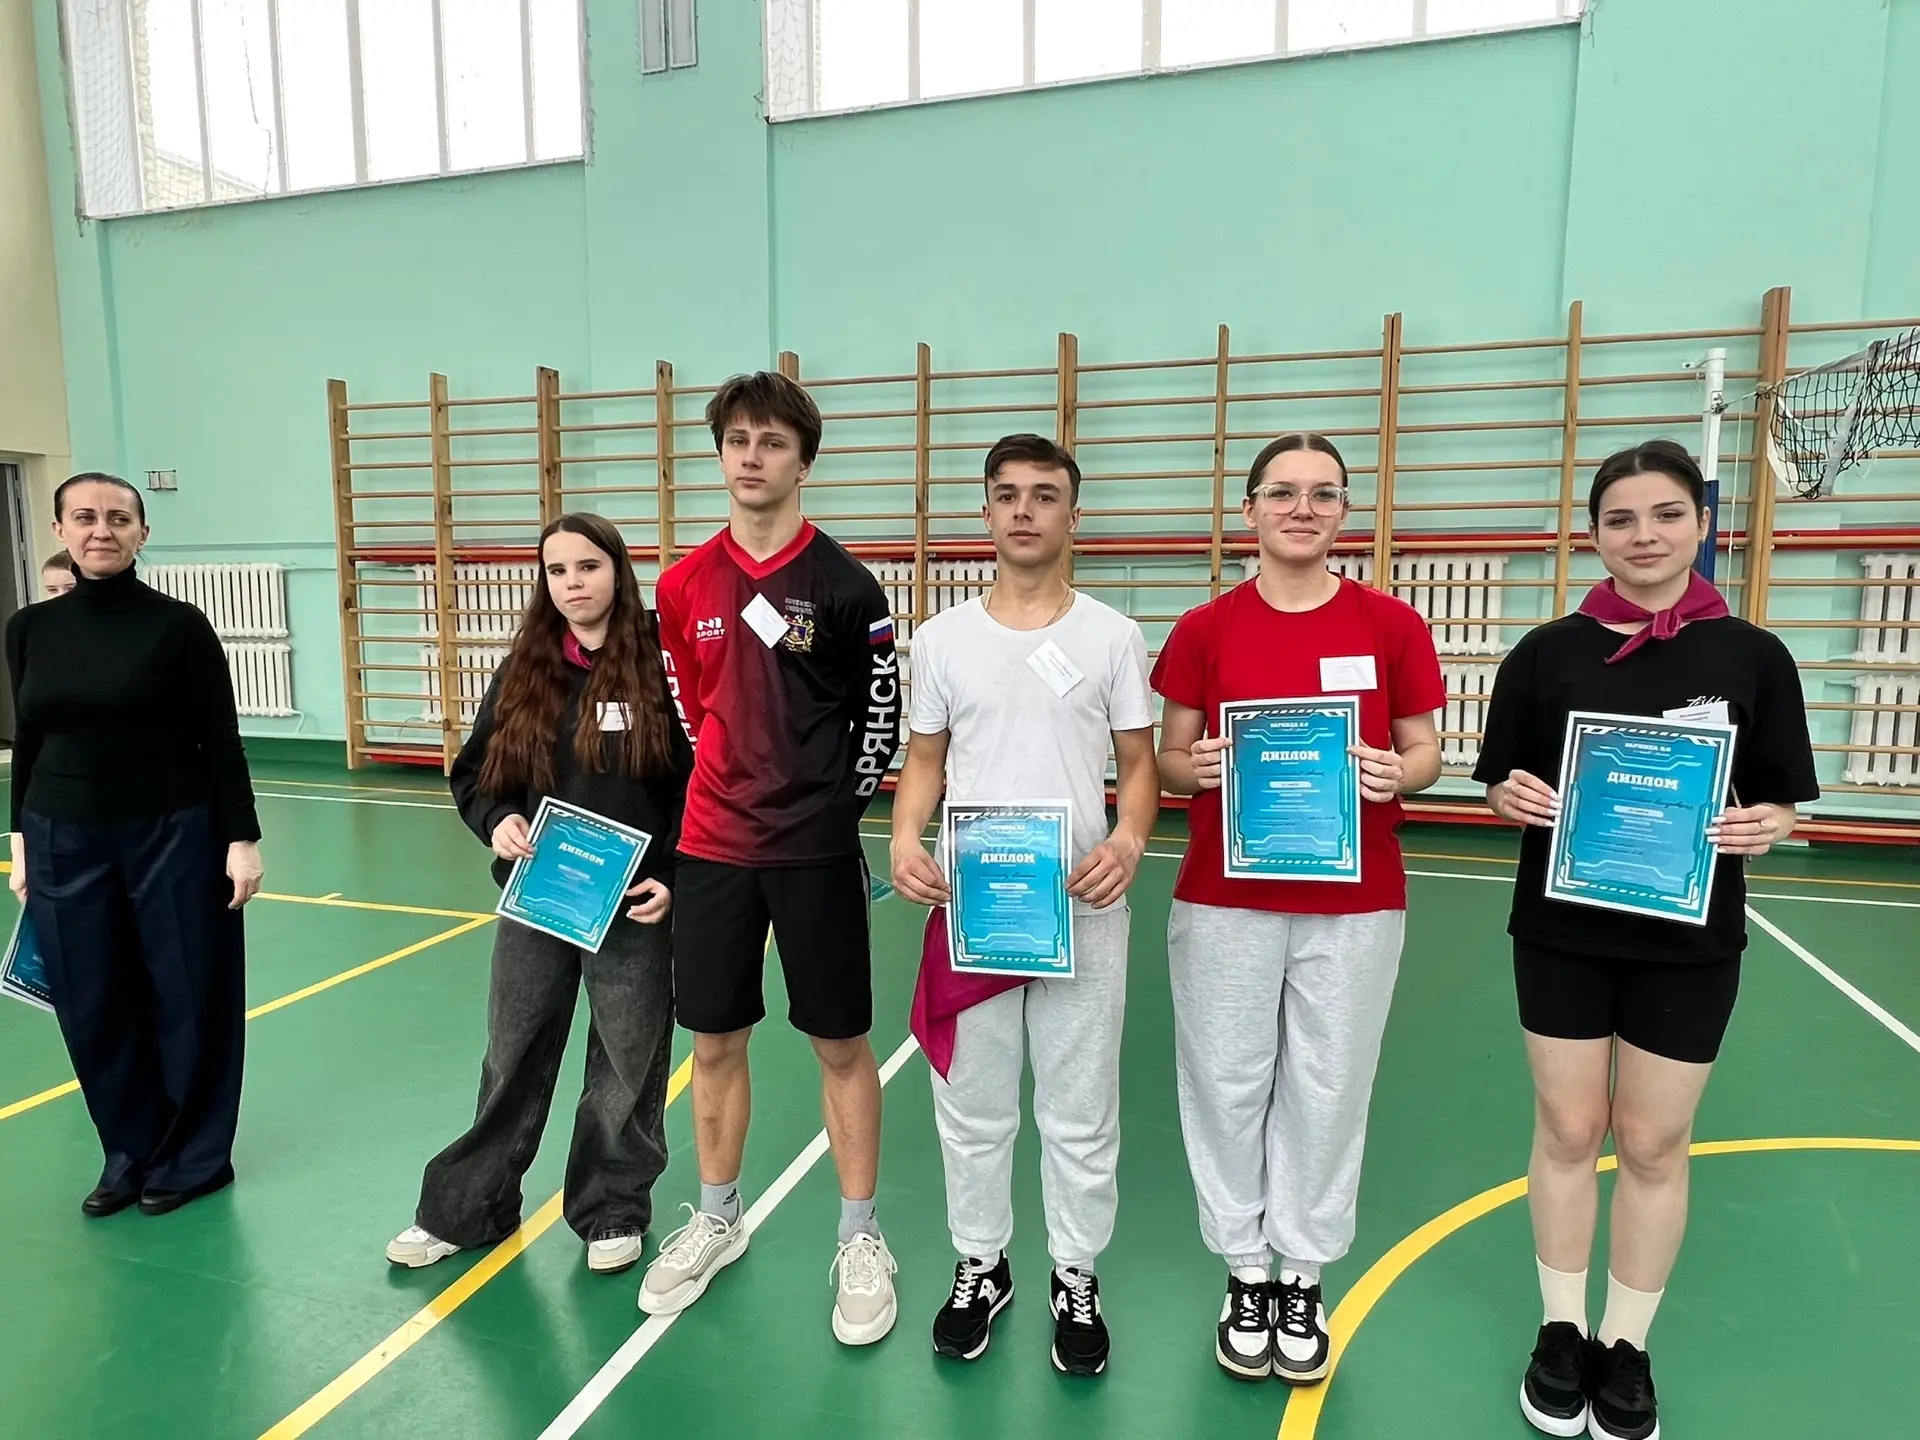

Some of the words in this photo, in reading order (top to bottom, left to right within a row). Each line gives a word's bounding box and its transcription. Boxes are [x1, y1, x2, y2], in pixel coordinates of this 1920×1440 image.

[696, 629, 726, 639] SPORT
[1261, 750, 1320, 762] ДИПЛОМ
[1606, 771, 1679, 791] ДИПЛОМ
[558, 842, 605, 866] ДИПЛОМ
[980, 852, 1036, 864] ДИПЛОМ
